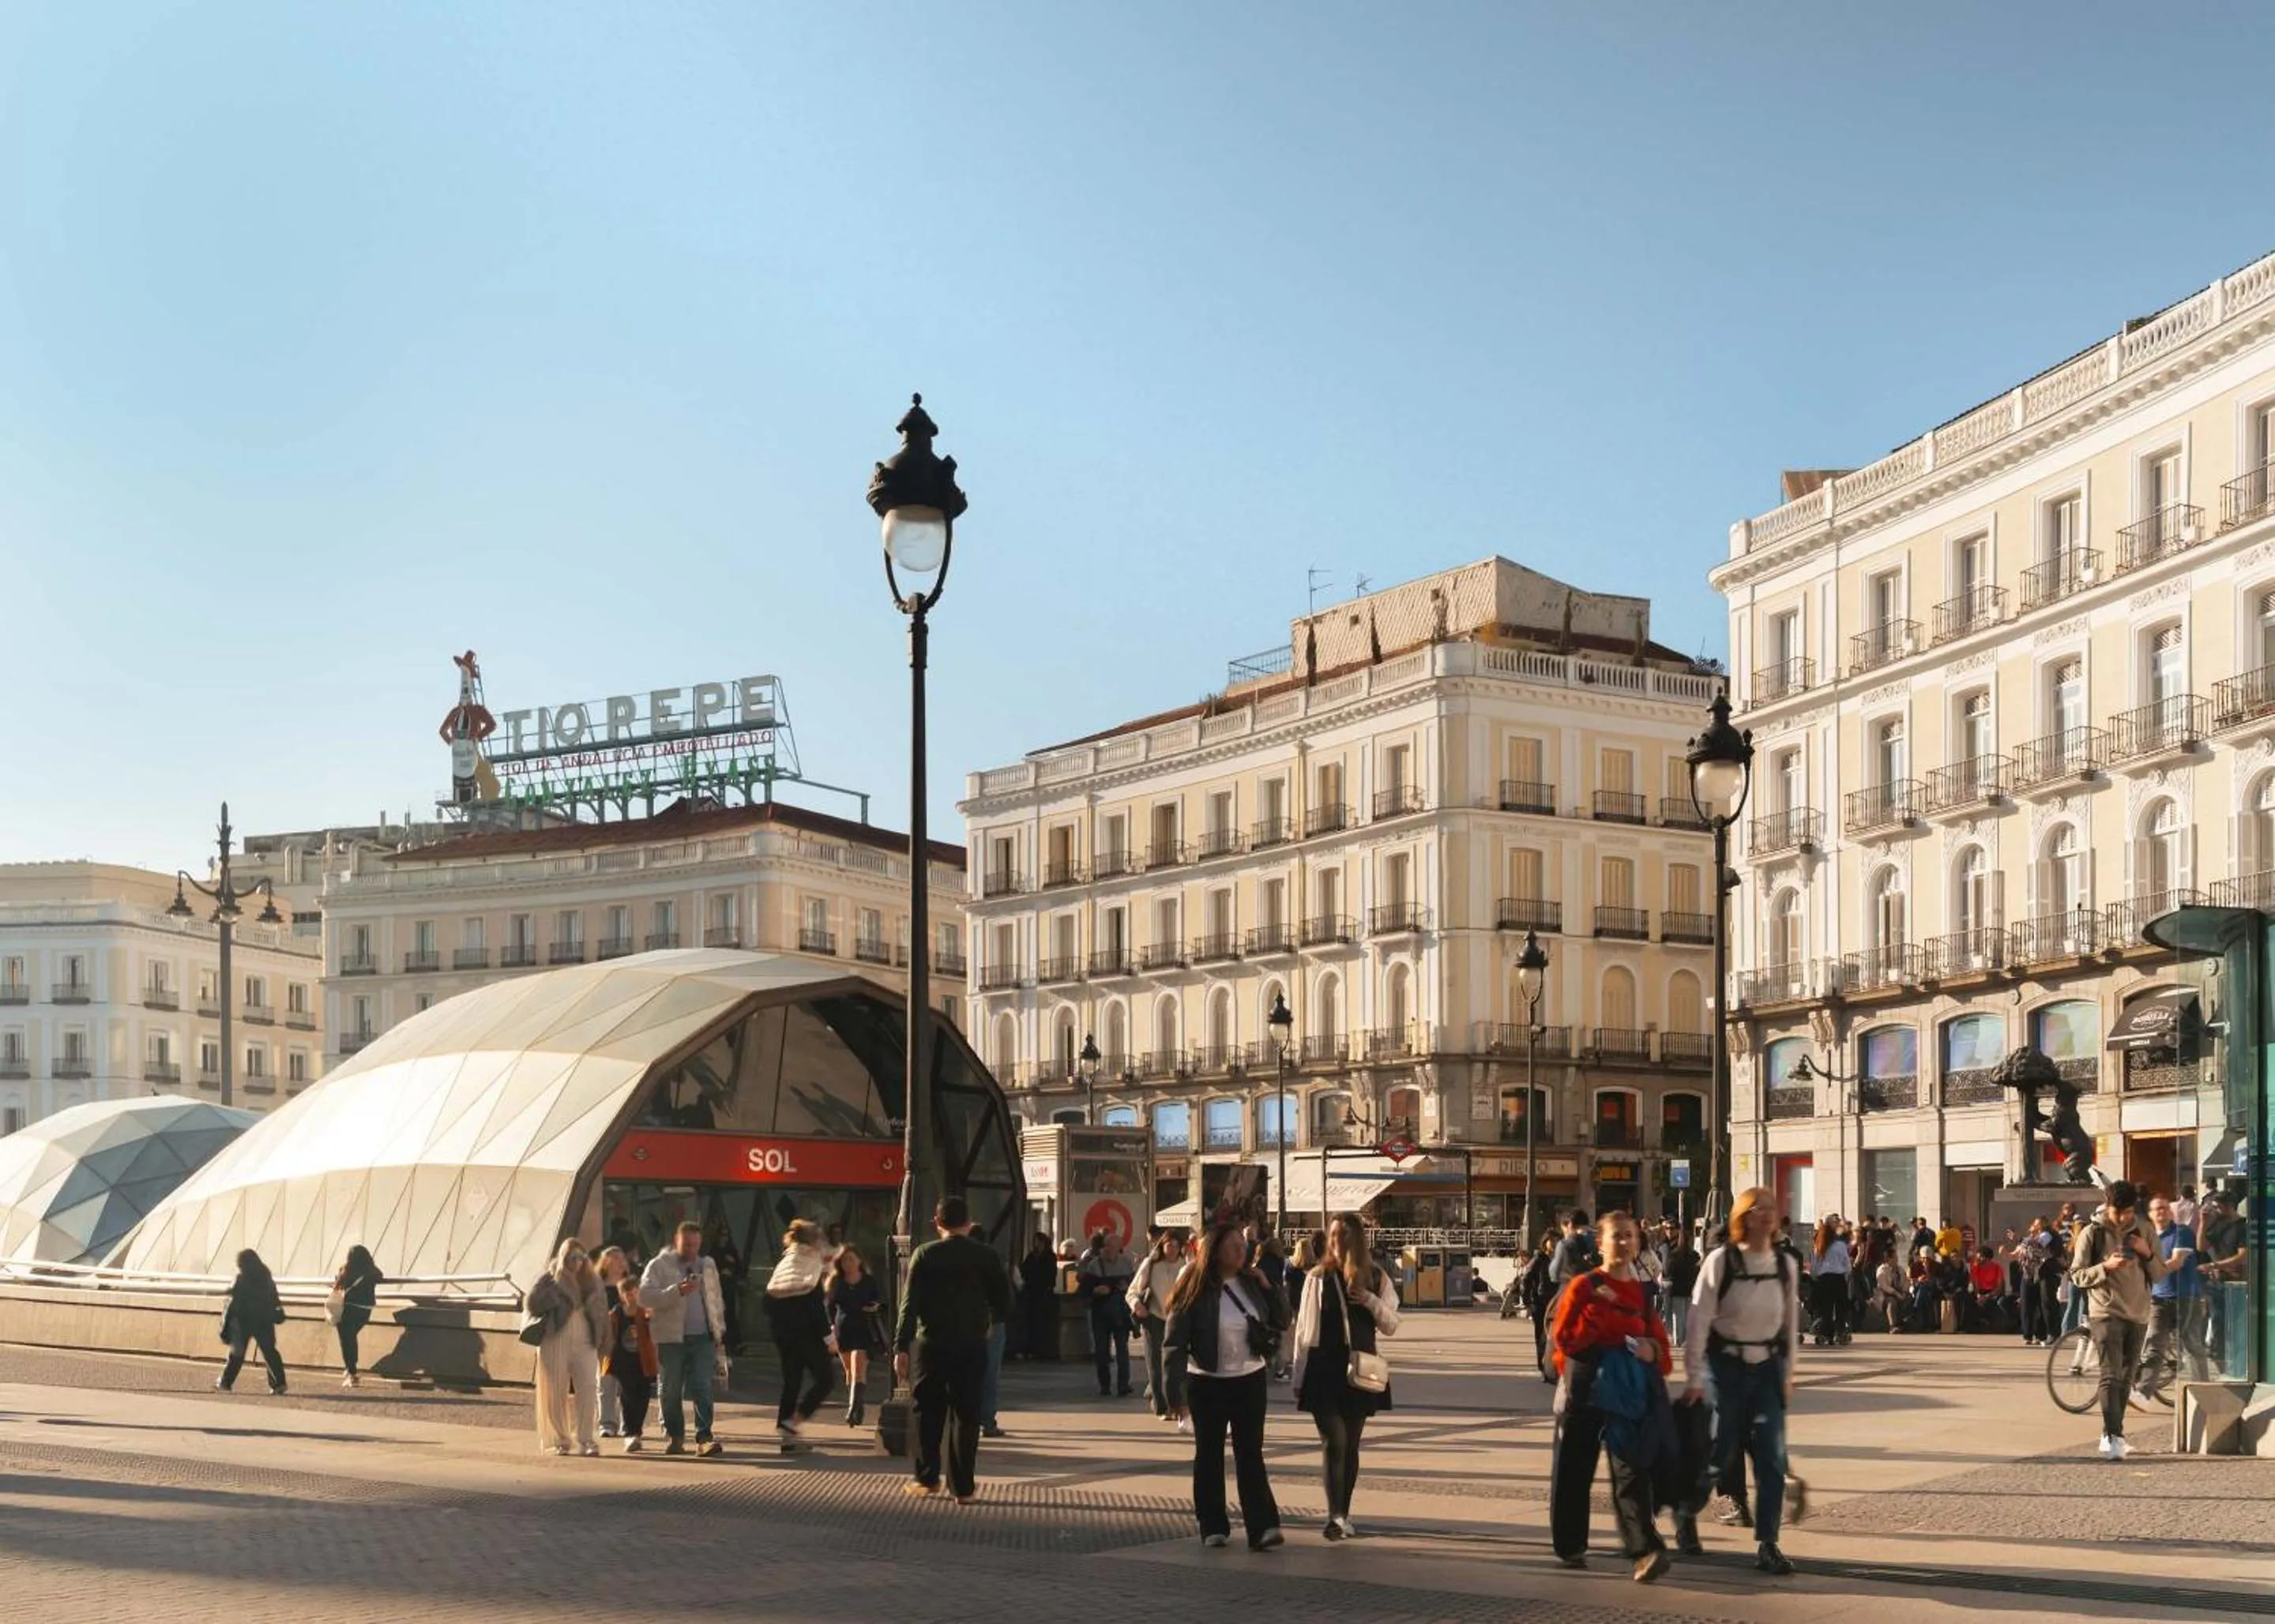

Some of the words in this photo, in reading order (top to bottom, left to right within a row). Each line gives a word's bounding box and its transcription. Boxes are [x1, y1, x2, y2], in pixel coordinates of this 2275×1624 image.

[503, 703, 587, 753] TIO
[607, 675, 773, 740] PEPE
[749, 1148, 796, 1173] SOL
